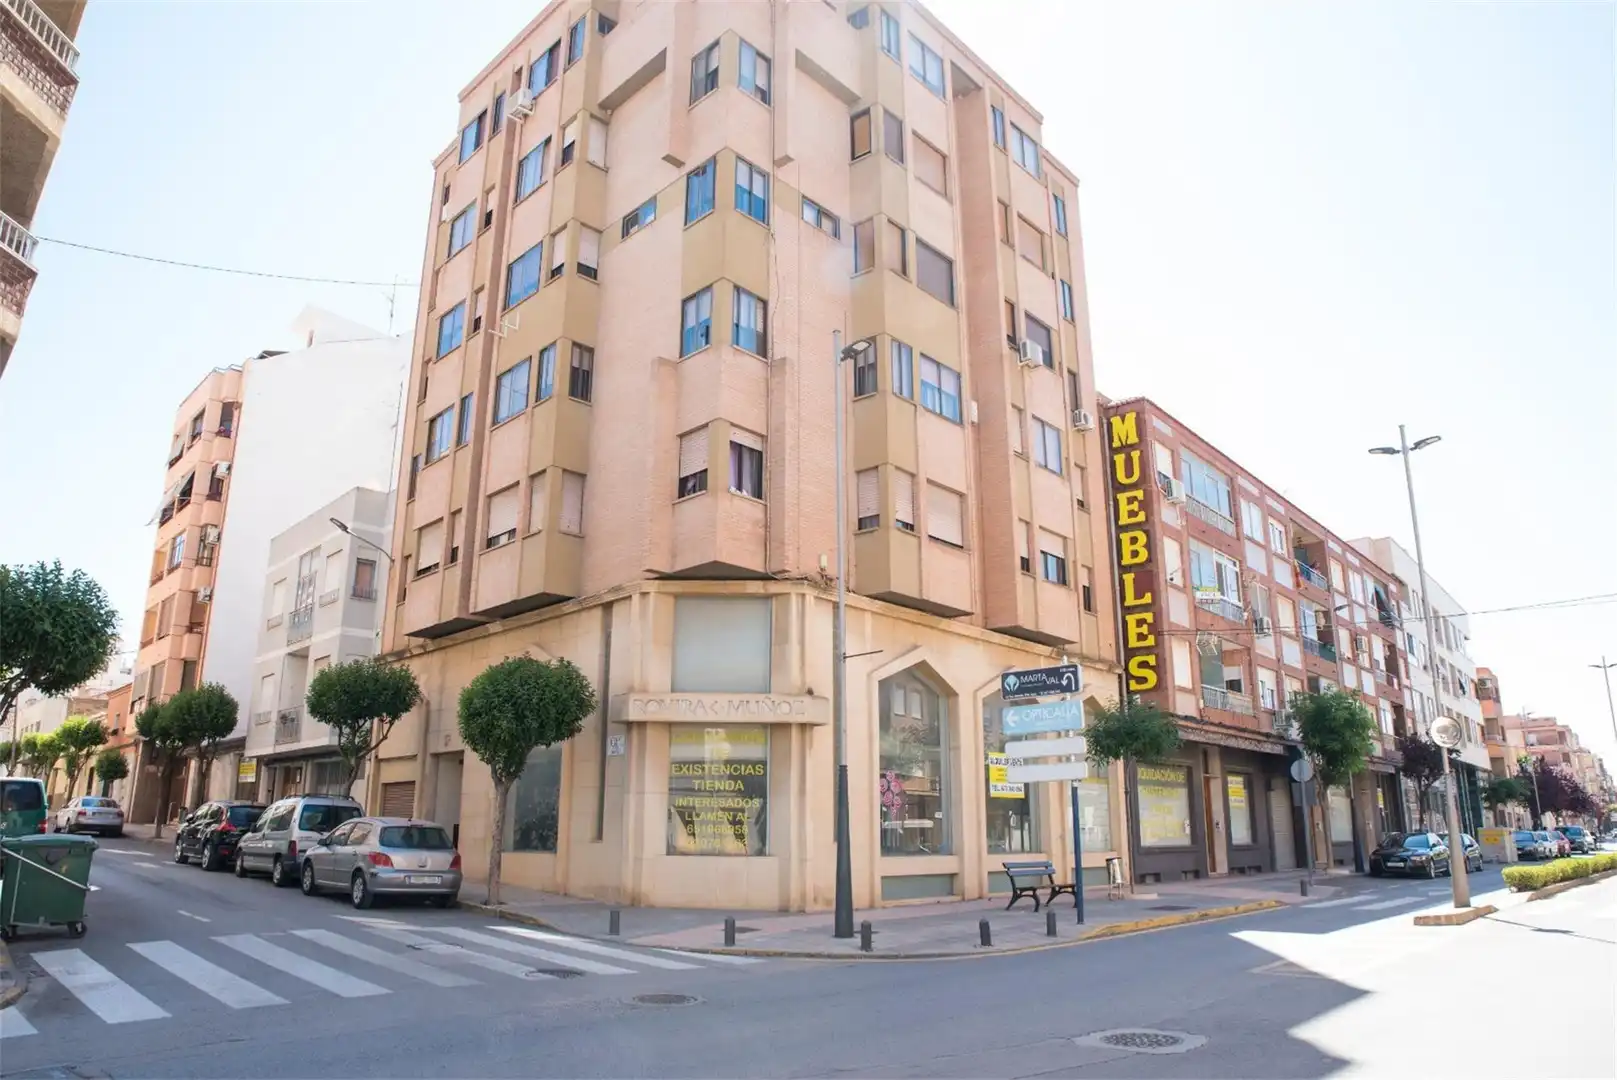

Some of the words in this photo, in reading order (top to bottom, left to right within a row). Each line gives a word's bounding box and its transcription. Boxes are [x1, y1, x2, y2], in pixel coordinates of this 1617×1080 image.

[1110, 411, 1158, 691] MUEBLES
[1020, 673, 1047, 684] MARTA
[672, 763, 764, 776] EXISTENCIAS
[692, 779, 745, 791] TIENDA
[675, 796, 760, 808] INTERESADOS
[685, 810, 733, 821] LLAMEN
